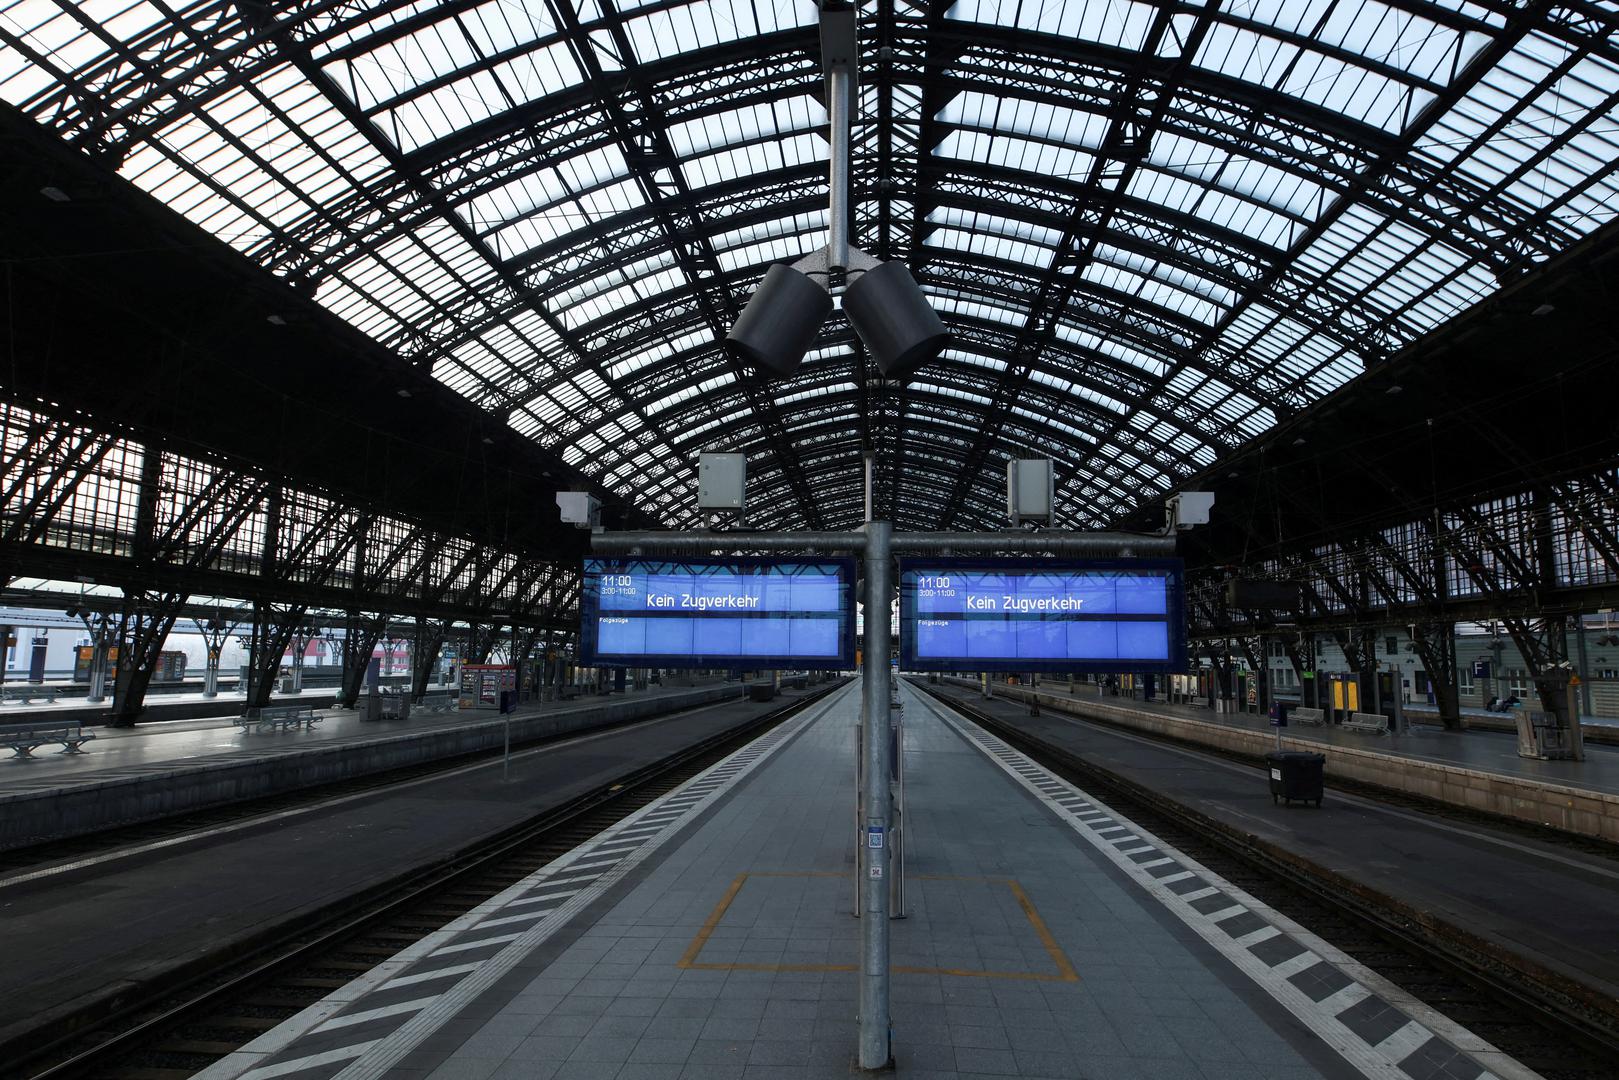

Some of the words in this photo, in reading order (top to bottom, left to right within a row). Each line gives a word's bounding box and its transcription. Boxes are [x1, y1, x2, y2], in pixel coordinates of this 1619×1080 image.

[602, 575, 631, 586] 11:00
[920, 577, 949, 588] 11:00
[601, 587, 636, 595] 3:00-11:00
[919, 589, 955, 597] 3:00-11:00
[647, 593, 674, 607] Kein
[681, 594, 759, 610] Zugverkehr
[967, 595, 996, 609] Kein
[1003, 596, 1083, 613] Zugverkehr
[1474, 662, 1482, 674] F
